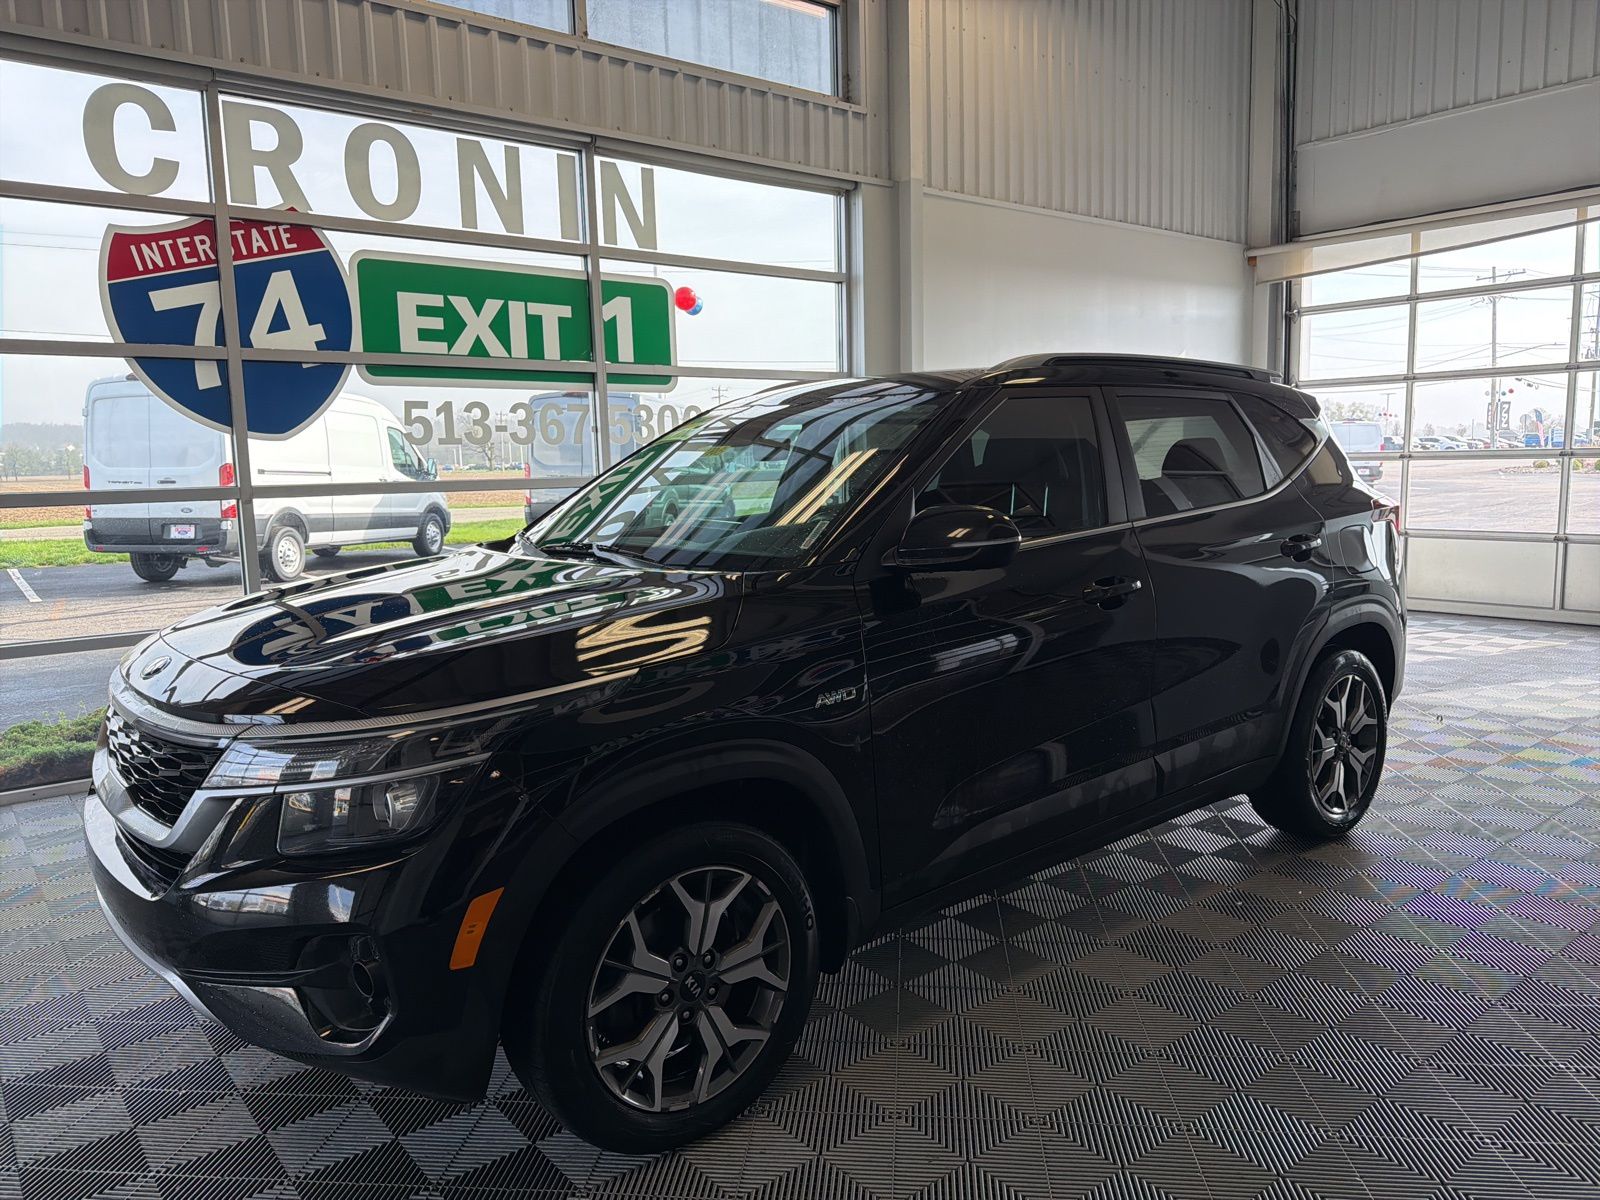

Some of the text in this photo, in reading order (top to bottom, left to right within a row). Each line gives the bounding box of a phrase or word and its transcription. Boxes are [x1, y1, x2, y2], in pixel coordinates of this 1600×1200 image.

[83, 83, 657, 250] CRONIN
[130, 225, 298, 271] INTERTATE
[148, 270, 327, 390] 74
[397, 291, 635, 363] EXIT 1
[815, 687, 856, 709] AWD
[685, 975, 702, 998] KIA
